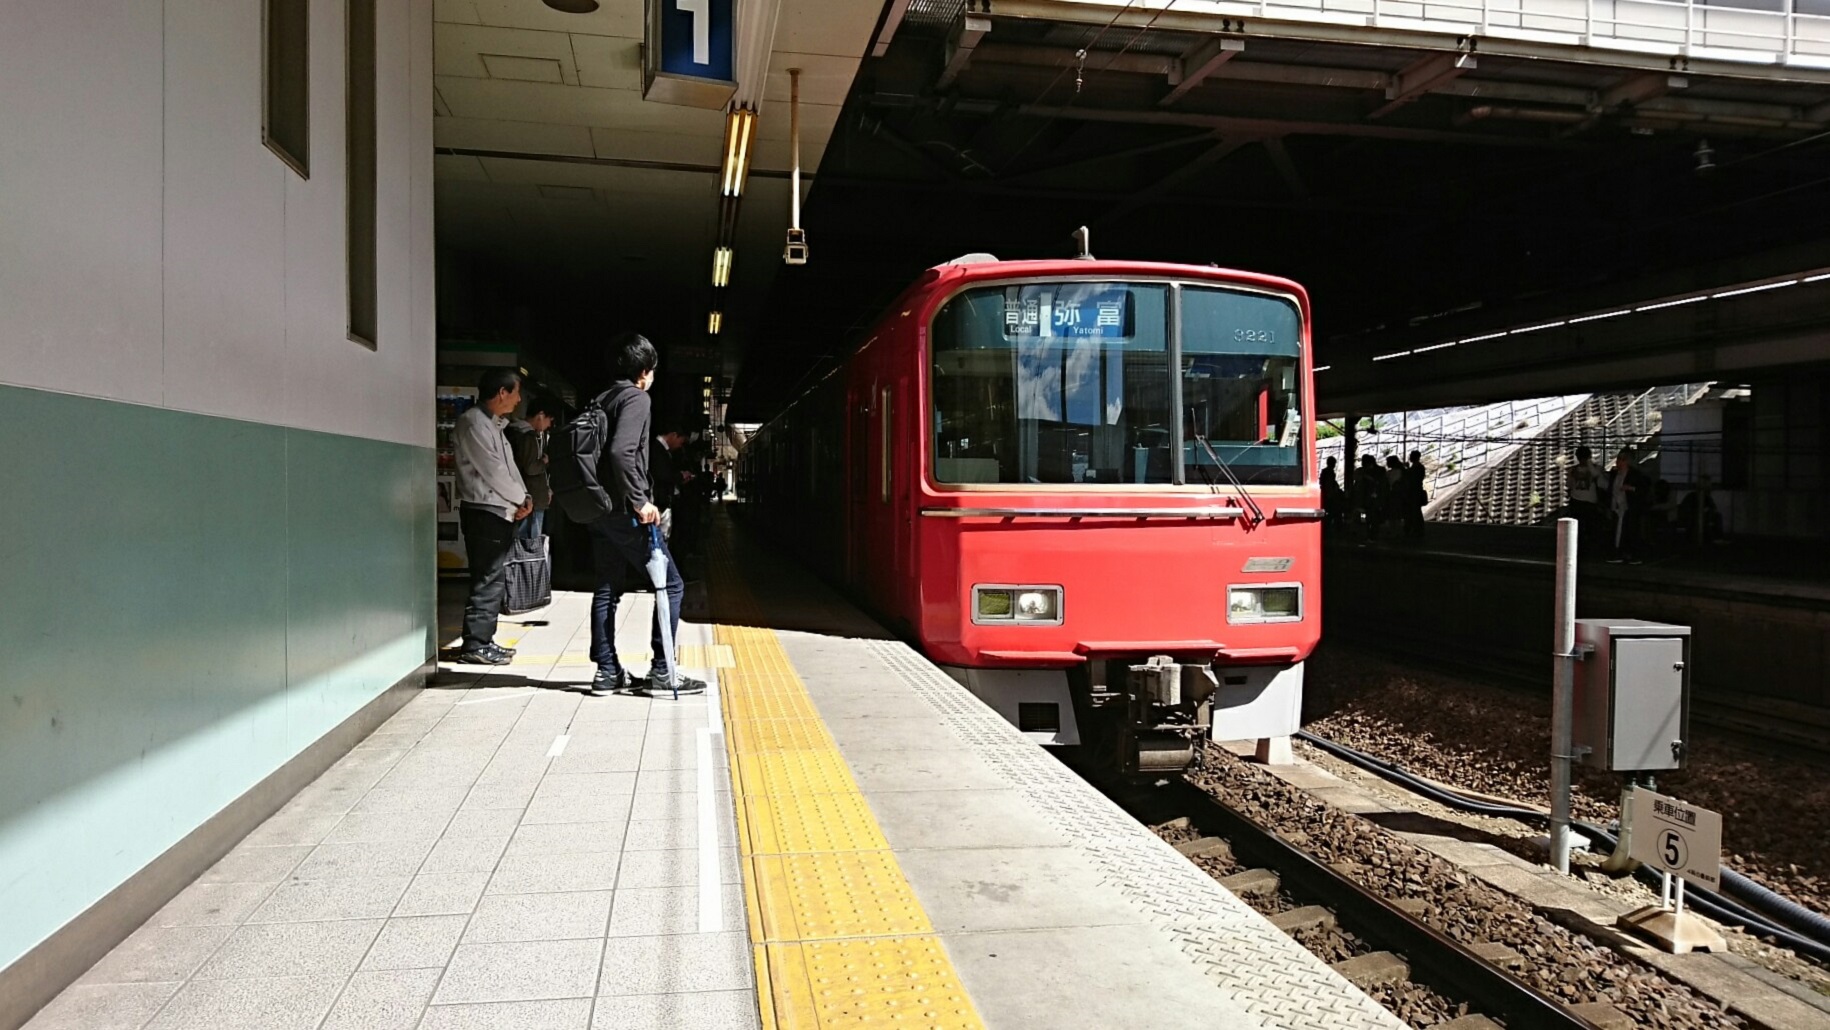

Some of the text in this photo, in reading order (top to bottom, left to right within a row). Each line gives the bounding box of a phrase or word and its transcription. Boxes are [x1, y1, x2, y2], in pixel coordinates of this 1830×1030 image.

[676, 0, 710, 65] 1
[1004, 298, 1039, 325] 普通
[1054, 299, 1122, 327] 弥富
[1010, 325, 1032, 334] Local
[1073, 326, 1104, 335] Yatomi
[1233, 328, 1276, 344] 3221
[1653, 799, 1697, 826] 乗車位置
[1664, 832, 1680, 866] 5
